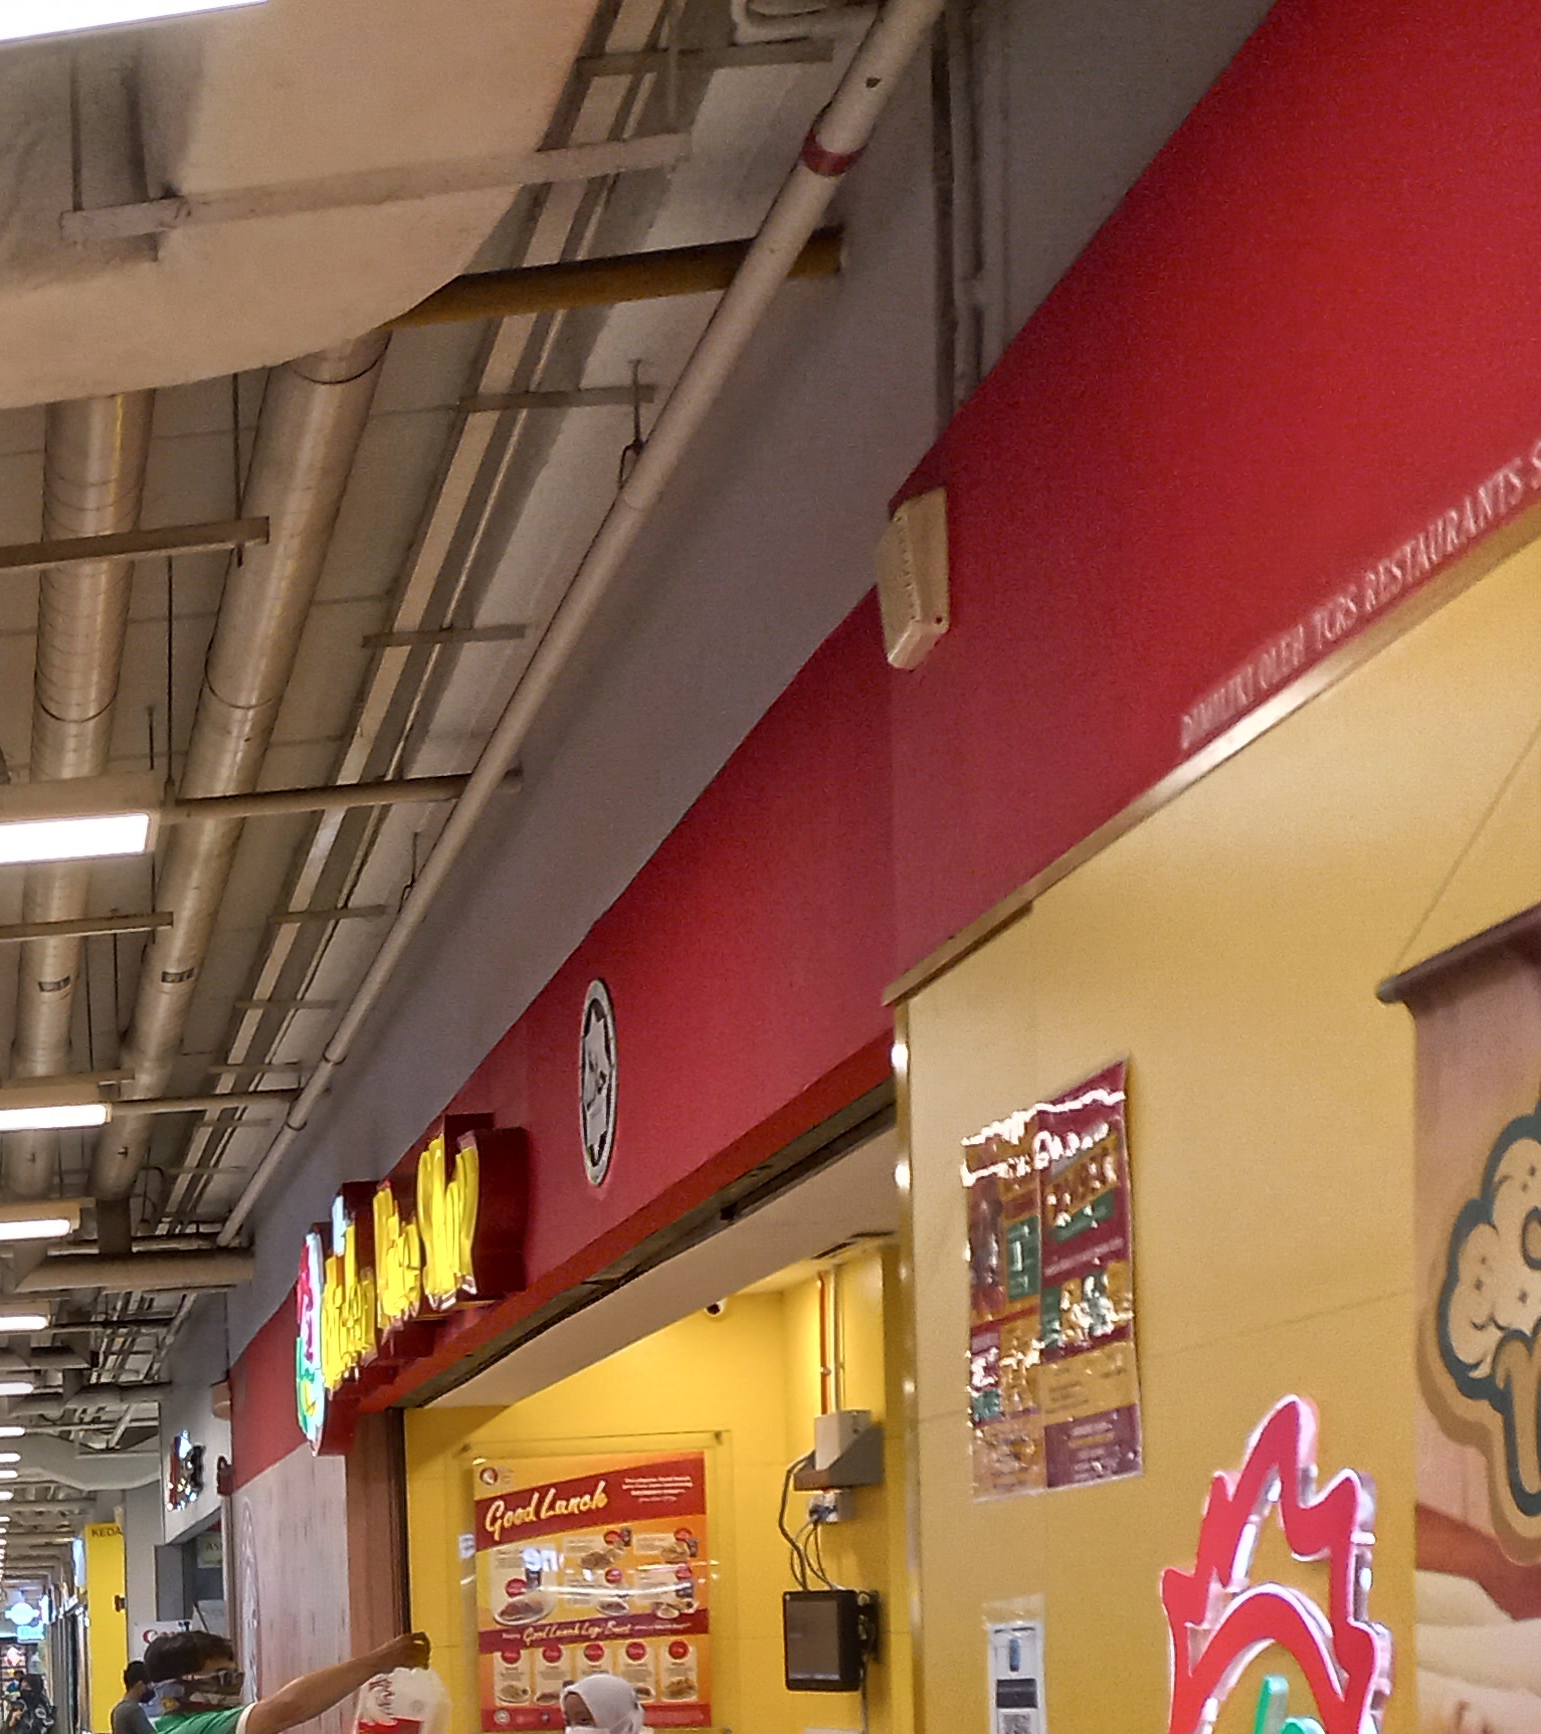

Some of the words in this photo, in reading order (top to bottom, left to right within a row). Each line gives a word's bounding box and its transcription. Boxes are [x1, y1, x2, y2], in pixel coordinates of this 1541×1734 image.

[1365, 457, 1523, 613] RESTAURANTS
[485, 1487, 538, 1542] Good
[540, 1480, 609, 1520] Lunch
